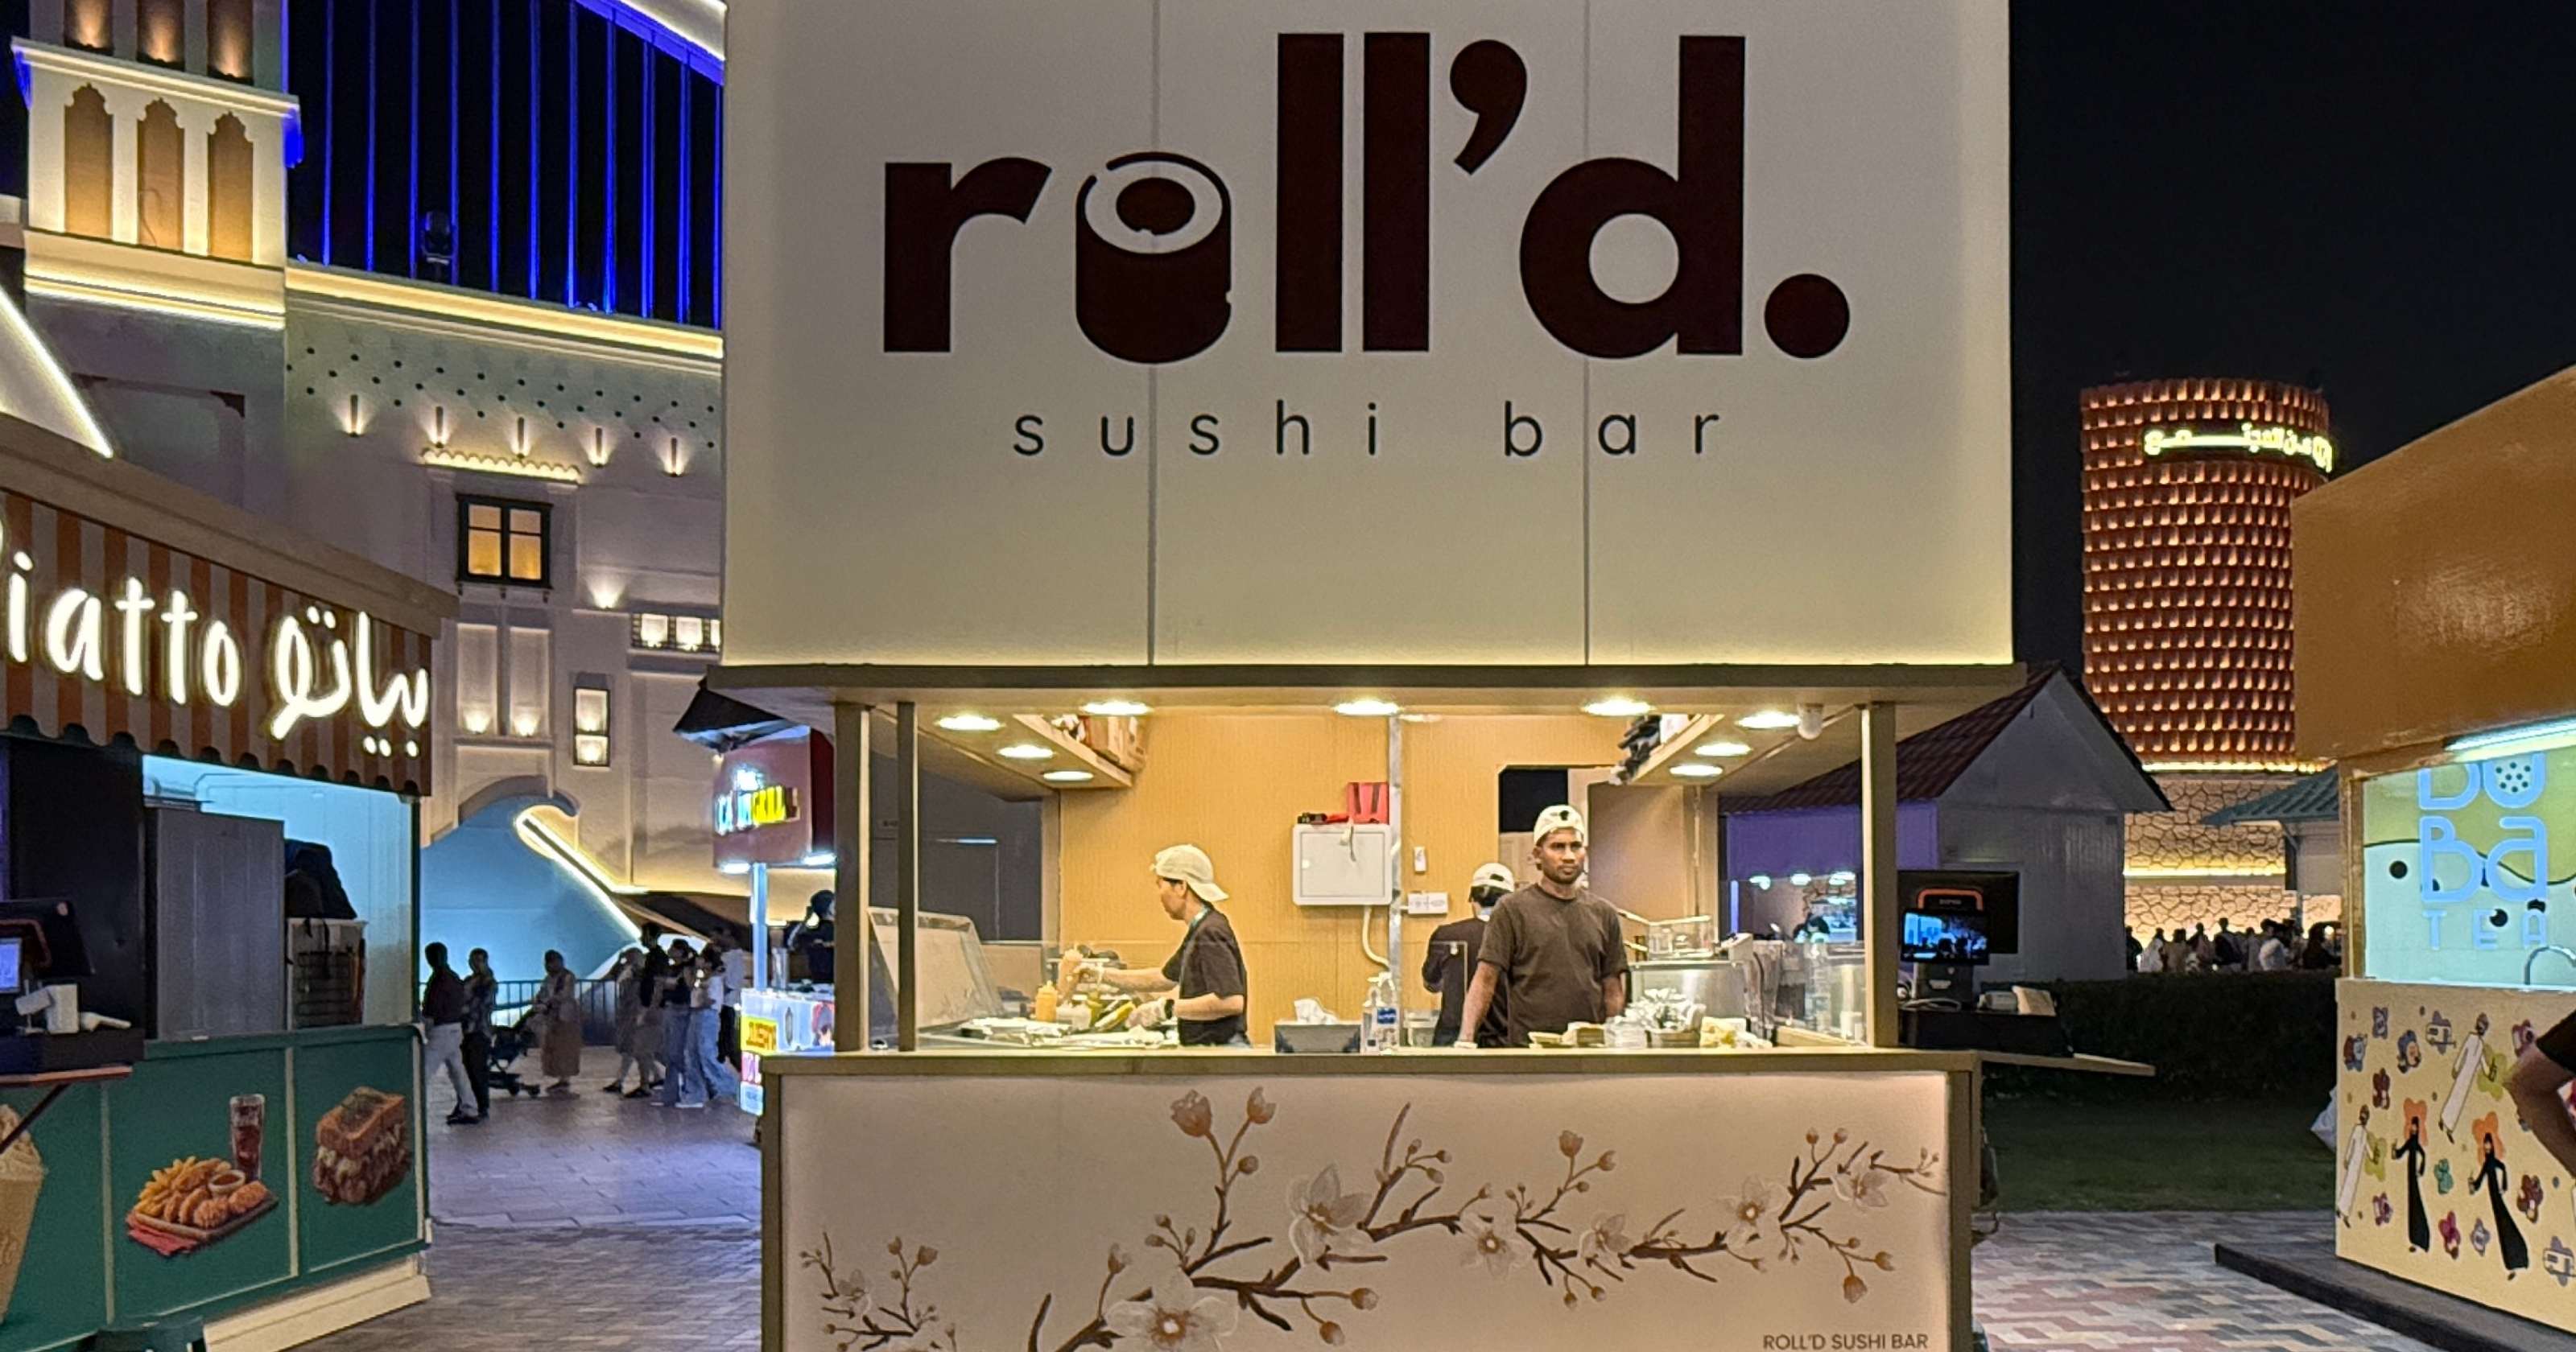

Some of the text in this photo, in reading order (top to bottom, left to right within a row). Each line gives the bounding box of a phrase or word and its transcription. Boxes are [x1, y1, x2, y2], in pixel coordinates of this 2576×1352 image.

[883, 31, 1851, 365] roll'd.
[1012, 400, 1720, 457] sushi bar
[0, 519, 241, 707] iatto
[270, 605, 429, 757] بياتو
[2422, 909, 2547, 950] TEA
[1763, 1333, 1929, 1350] ROLL'D SUSHI BAR
